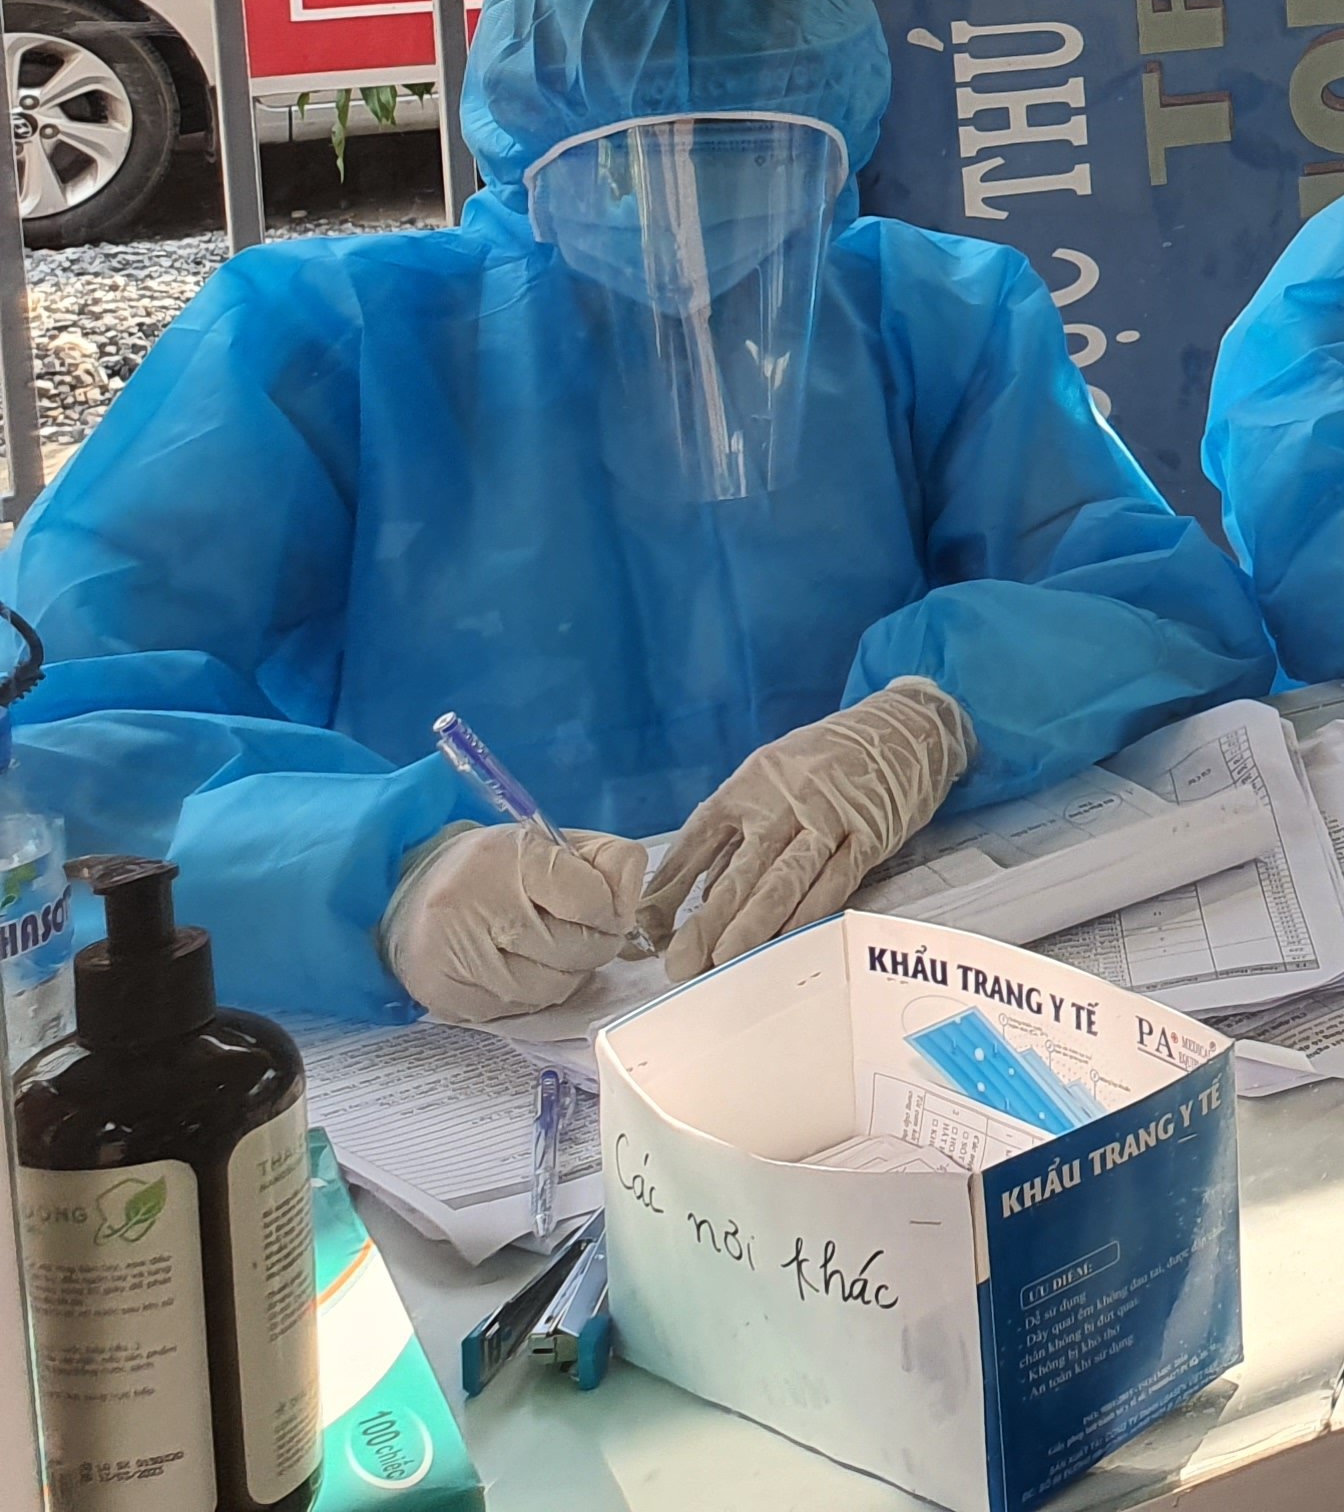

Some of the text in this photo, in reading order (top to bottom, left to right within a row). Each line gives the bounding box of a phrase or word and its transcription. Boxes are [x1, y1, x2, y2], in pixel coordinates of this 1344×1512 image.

[907, 19, 1091, 221] THÚ
[868, 945, 948, 986] KHẨU
[957, 965, 1043, 1014] TRANG
[1049, 993, 1064, 1023] Y
[1071, 1002, 1099, 1037] TẾ
[616, 1133, 898, 1309] Các nơi khác
[1002, 1072, 1222, 1218] KHẨU TRANG Y TẾ
